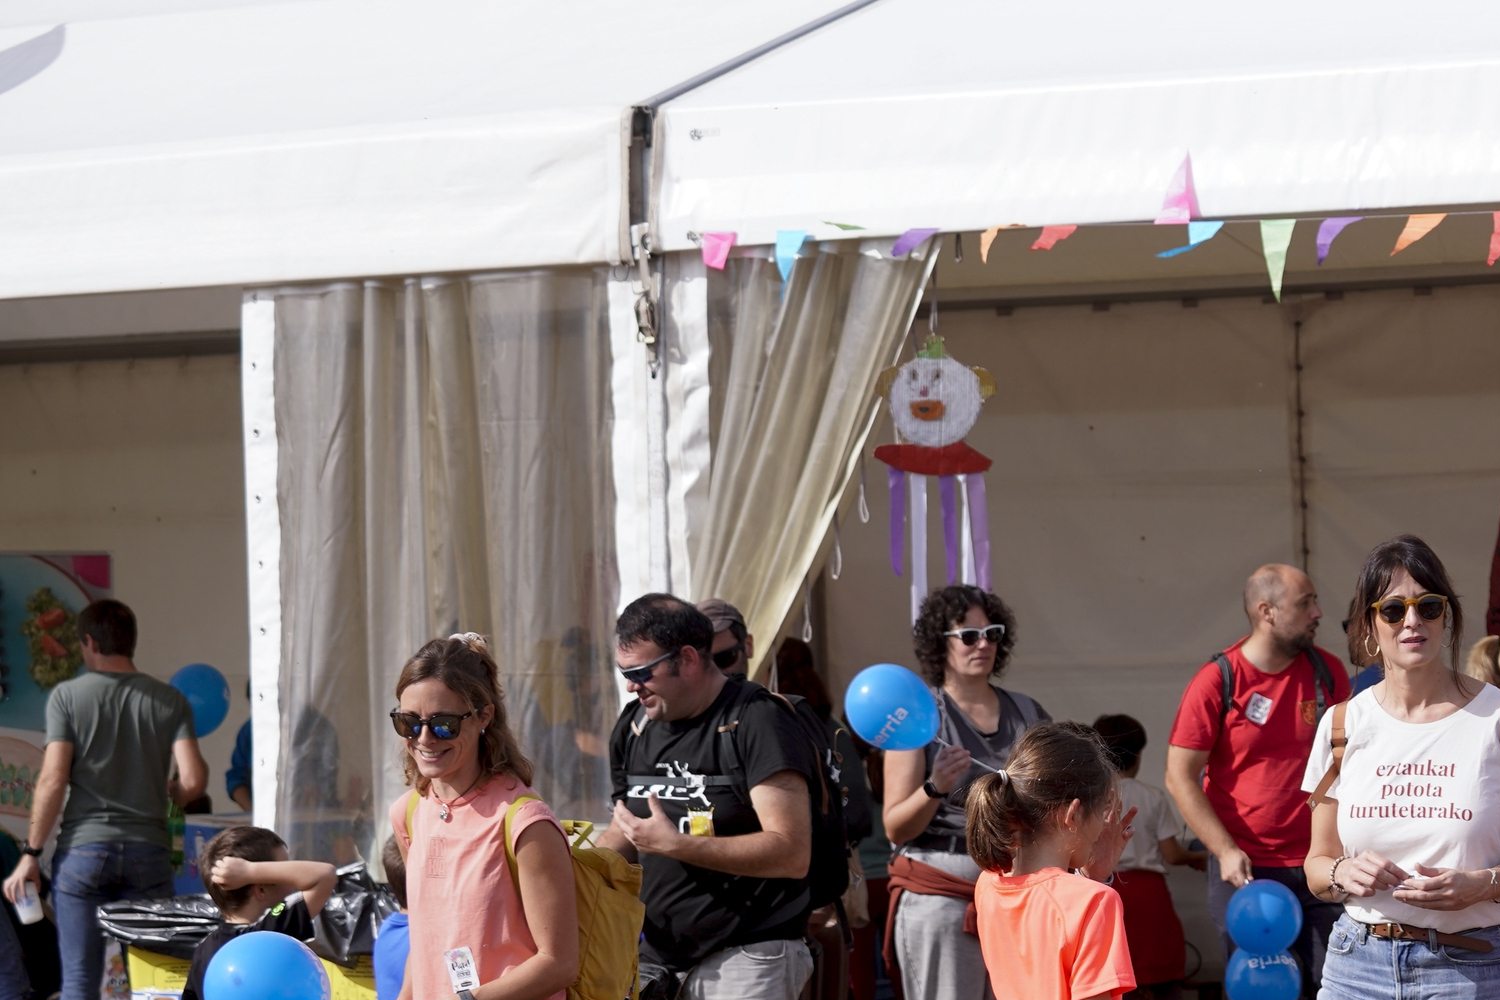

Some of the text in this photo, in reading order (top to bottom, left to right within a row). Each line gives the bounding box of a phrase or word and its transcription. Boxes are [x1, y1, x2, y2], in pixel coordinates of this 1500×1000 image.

[1376, 759, 1456, 778] eztaukat
[1381, 782, 1443, 799] potota
[1350, 803, 1474, 822] turutetarako
